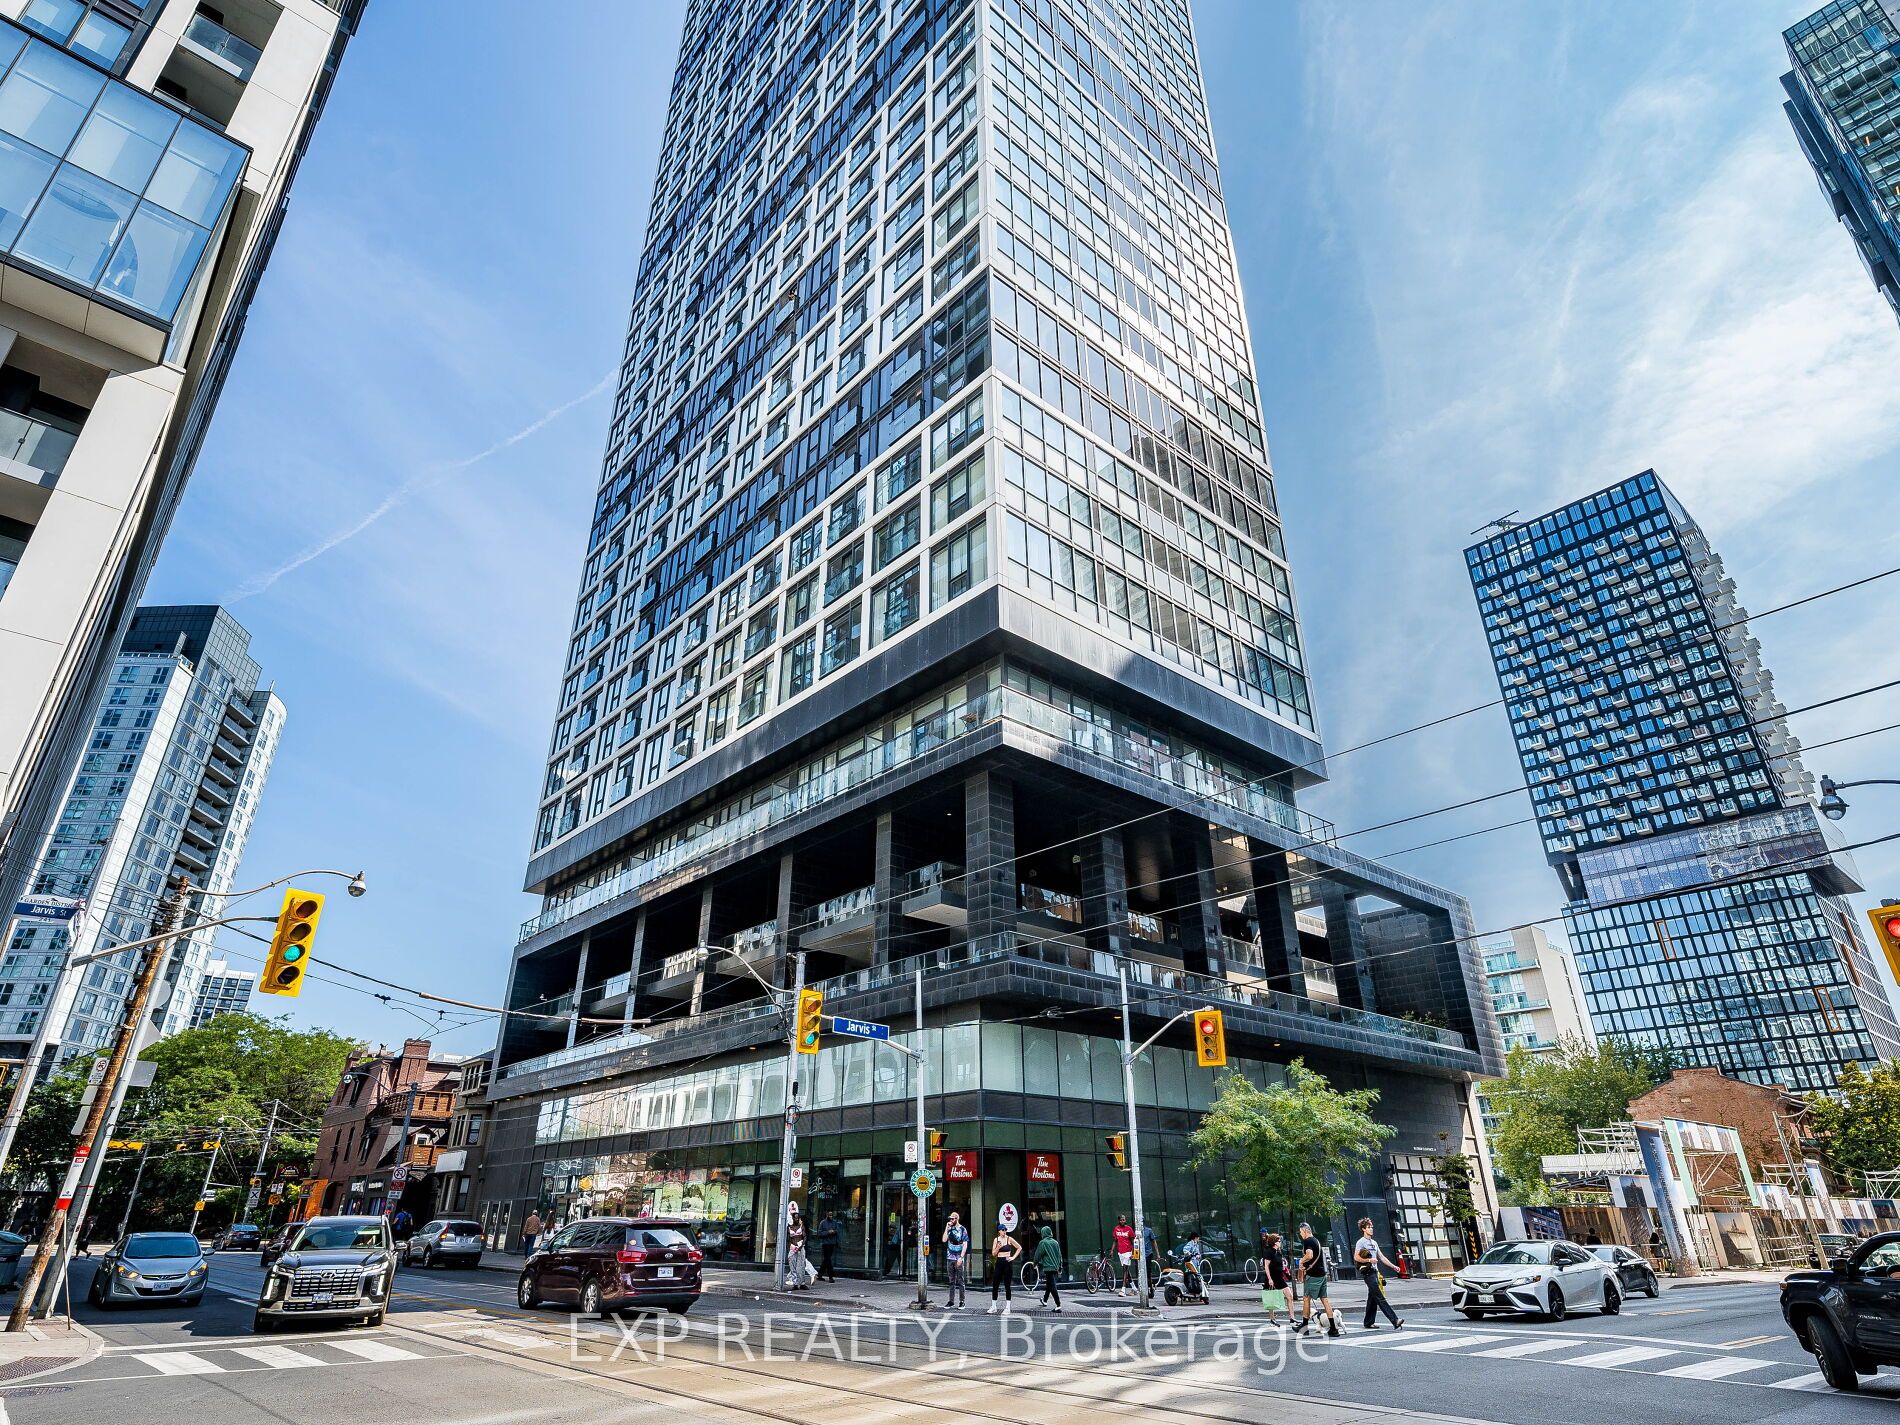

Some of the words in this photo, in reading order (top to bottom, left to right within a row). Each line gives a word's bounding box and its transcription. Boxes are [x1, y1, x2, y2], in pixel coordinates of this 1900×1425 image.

[31, 905, 56, 916] Jarvis
[60, 909, 68, 917] St
[846, 1020, 870, 1034] Jarvis
[955, 1155, 966, 1166] Tim
[1036, 1156, 1048, 1167] Tim
[950, 1166, 973, 1178] Hortons
[1032, 1167, 1055, 1179] Hortons
